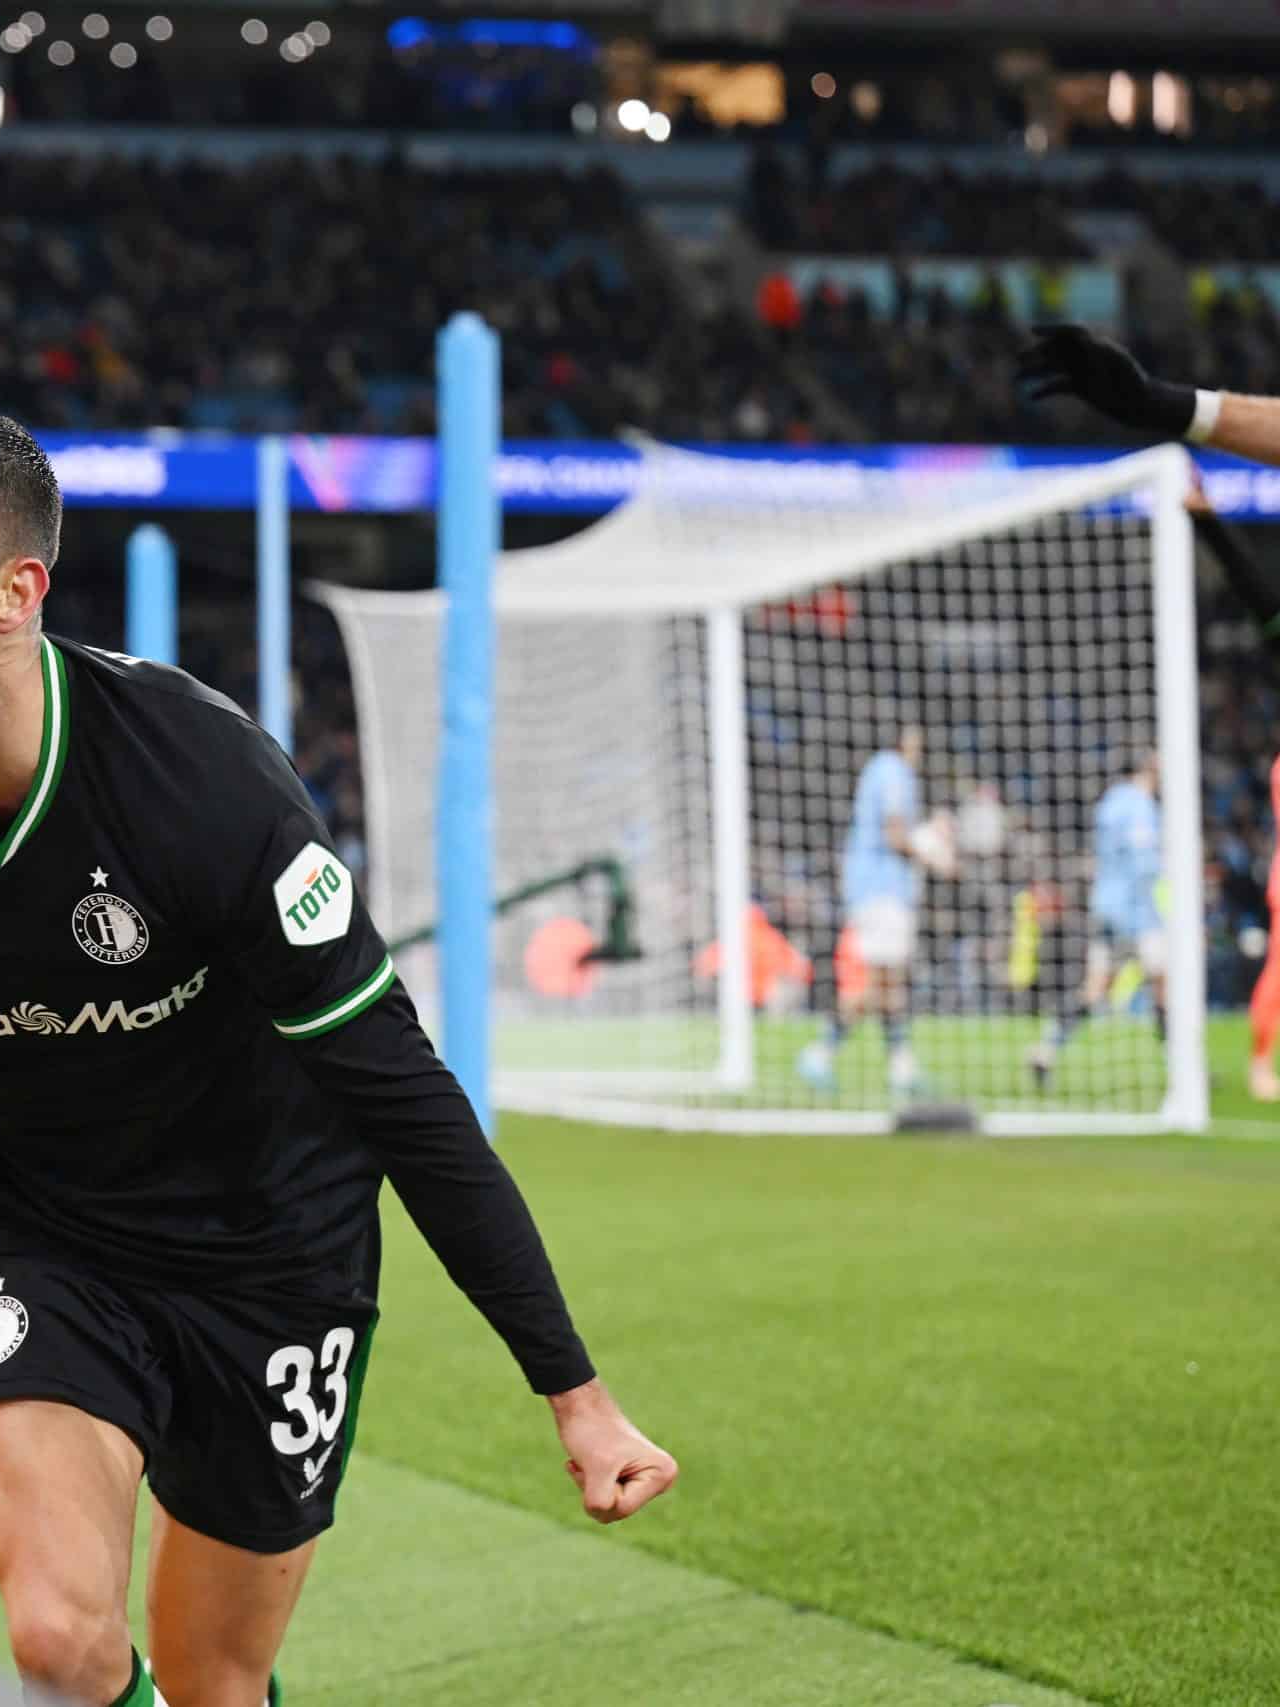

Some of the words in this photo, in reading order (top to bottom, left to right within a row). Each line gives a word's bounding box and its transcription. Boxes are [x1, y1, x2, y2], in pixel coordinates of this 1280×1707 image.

[76, 895, 137, 920] FEYENOORD
[286, 864, 341, 931] TOTO
[83, 936, 146, 961] ROTTERDAM
[266, 1326, 354, 1455] 33
